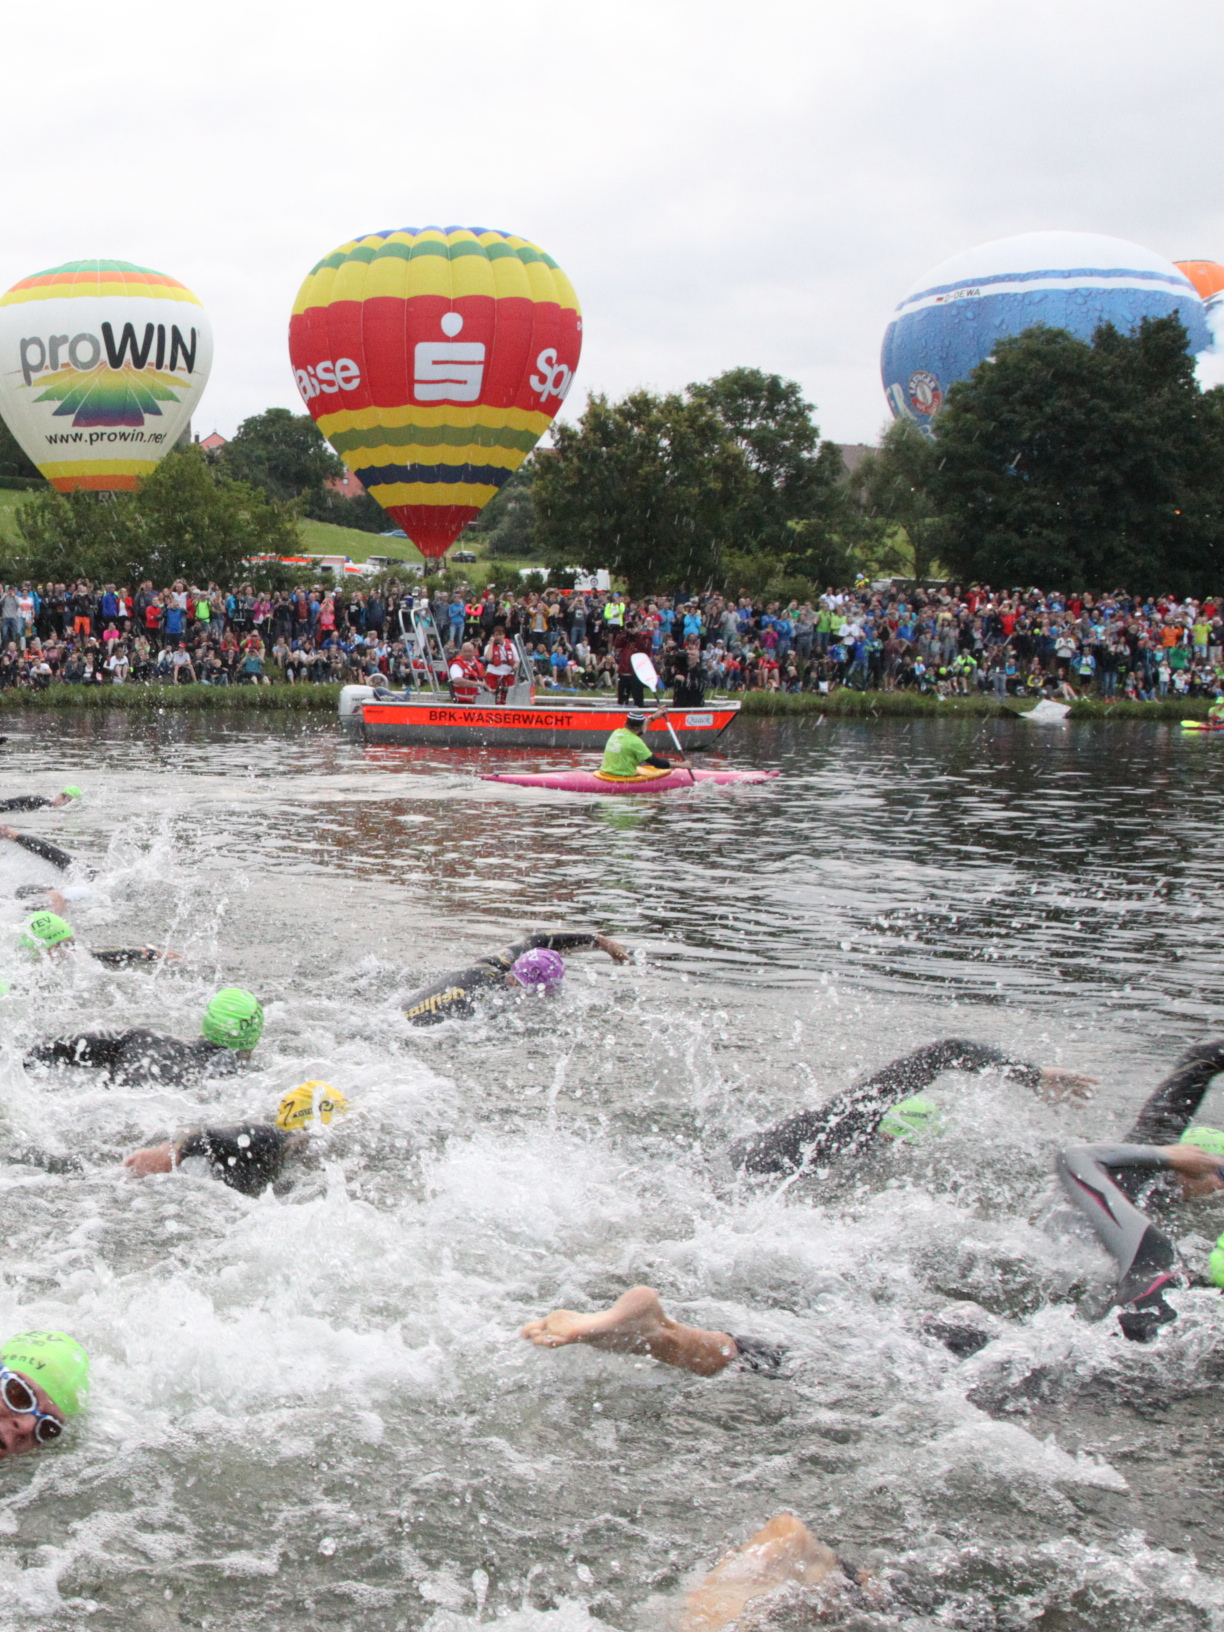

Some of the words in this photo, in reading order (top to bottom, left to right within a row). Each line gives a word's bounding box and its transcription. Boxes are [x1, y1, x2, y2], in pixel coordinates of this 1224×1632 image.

[20, 321, 197, 387] proWIN
[293, 357, 361, 403] asse
[45, 429, 167, 445] www.prowin.net
[429, 710, 573, 727] BRK-WASSERWACHT
